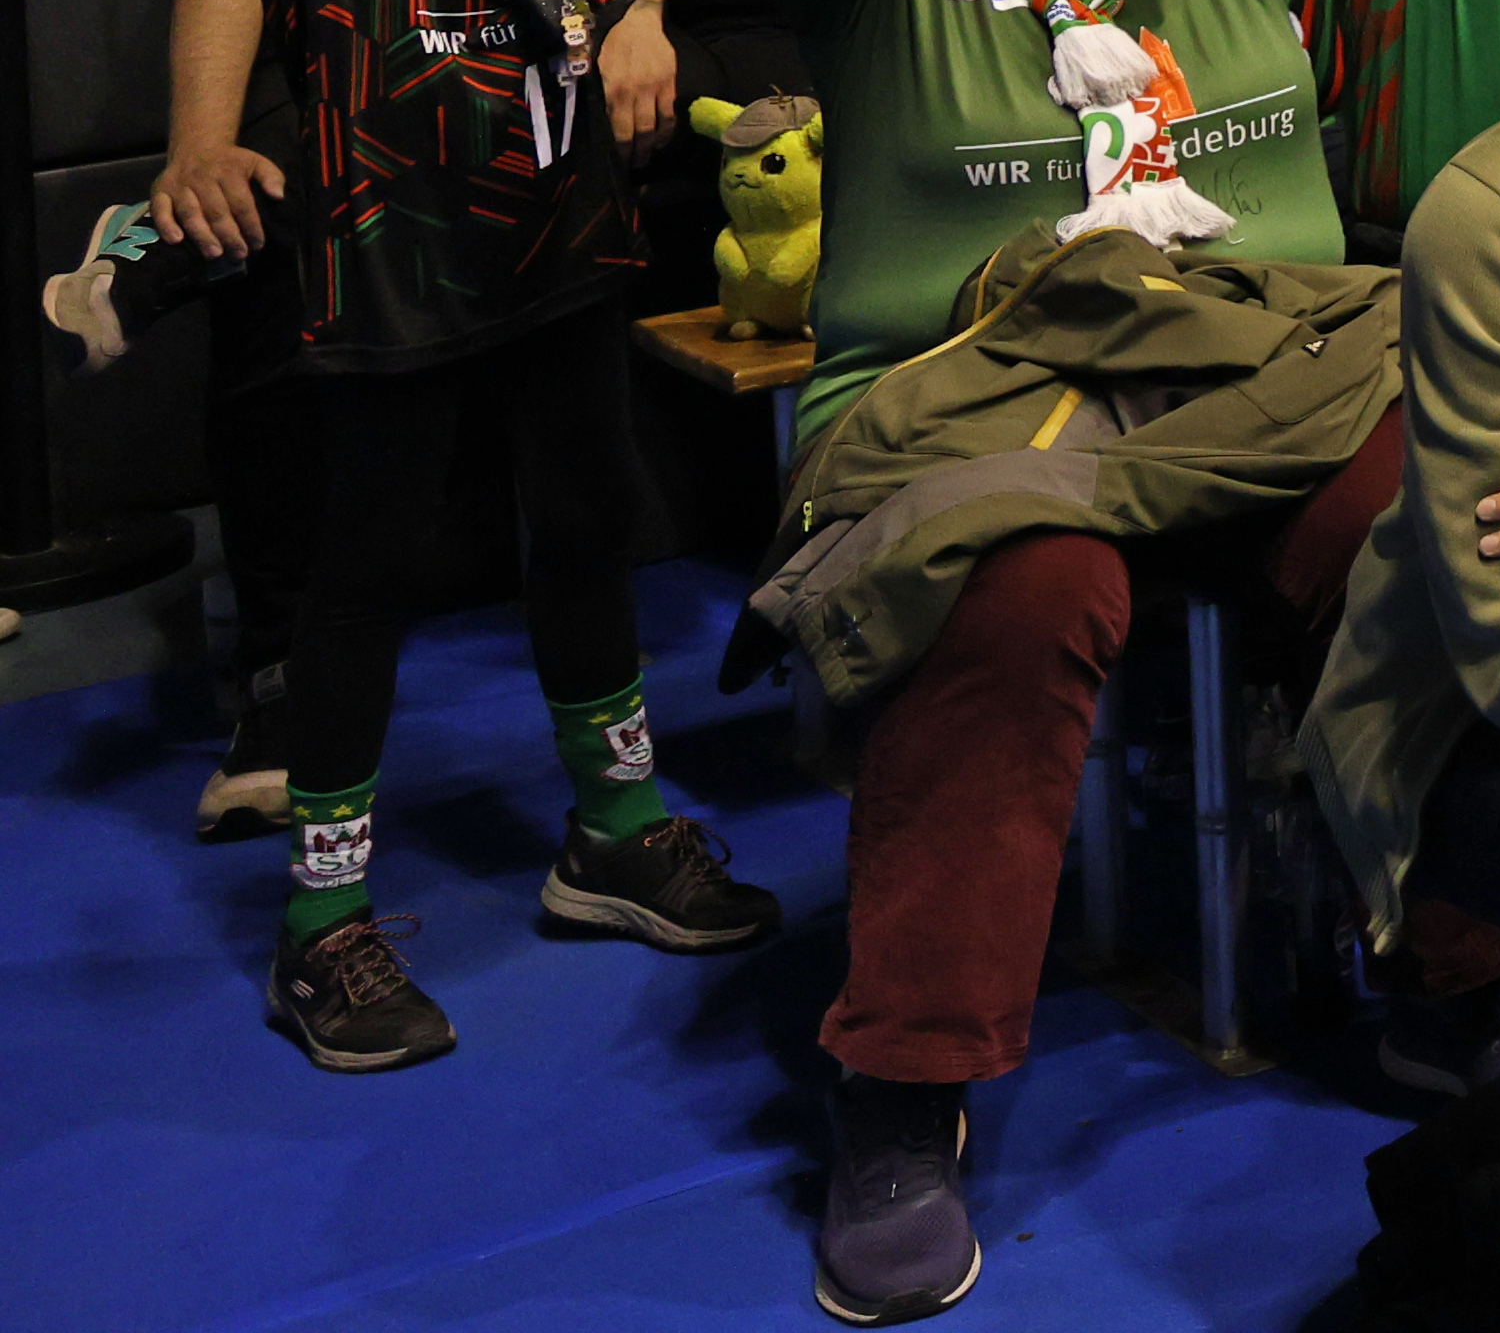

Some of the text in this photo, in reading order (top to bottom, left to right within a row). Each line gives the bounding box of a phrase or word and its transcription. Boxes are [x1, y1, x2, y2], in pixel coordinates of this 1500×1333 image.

[420, 23, 517, 54] WIR für
[964, 161, 1032, 187] WIR
